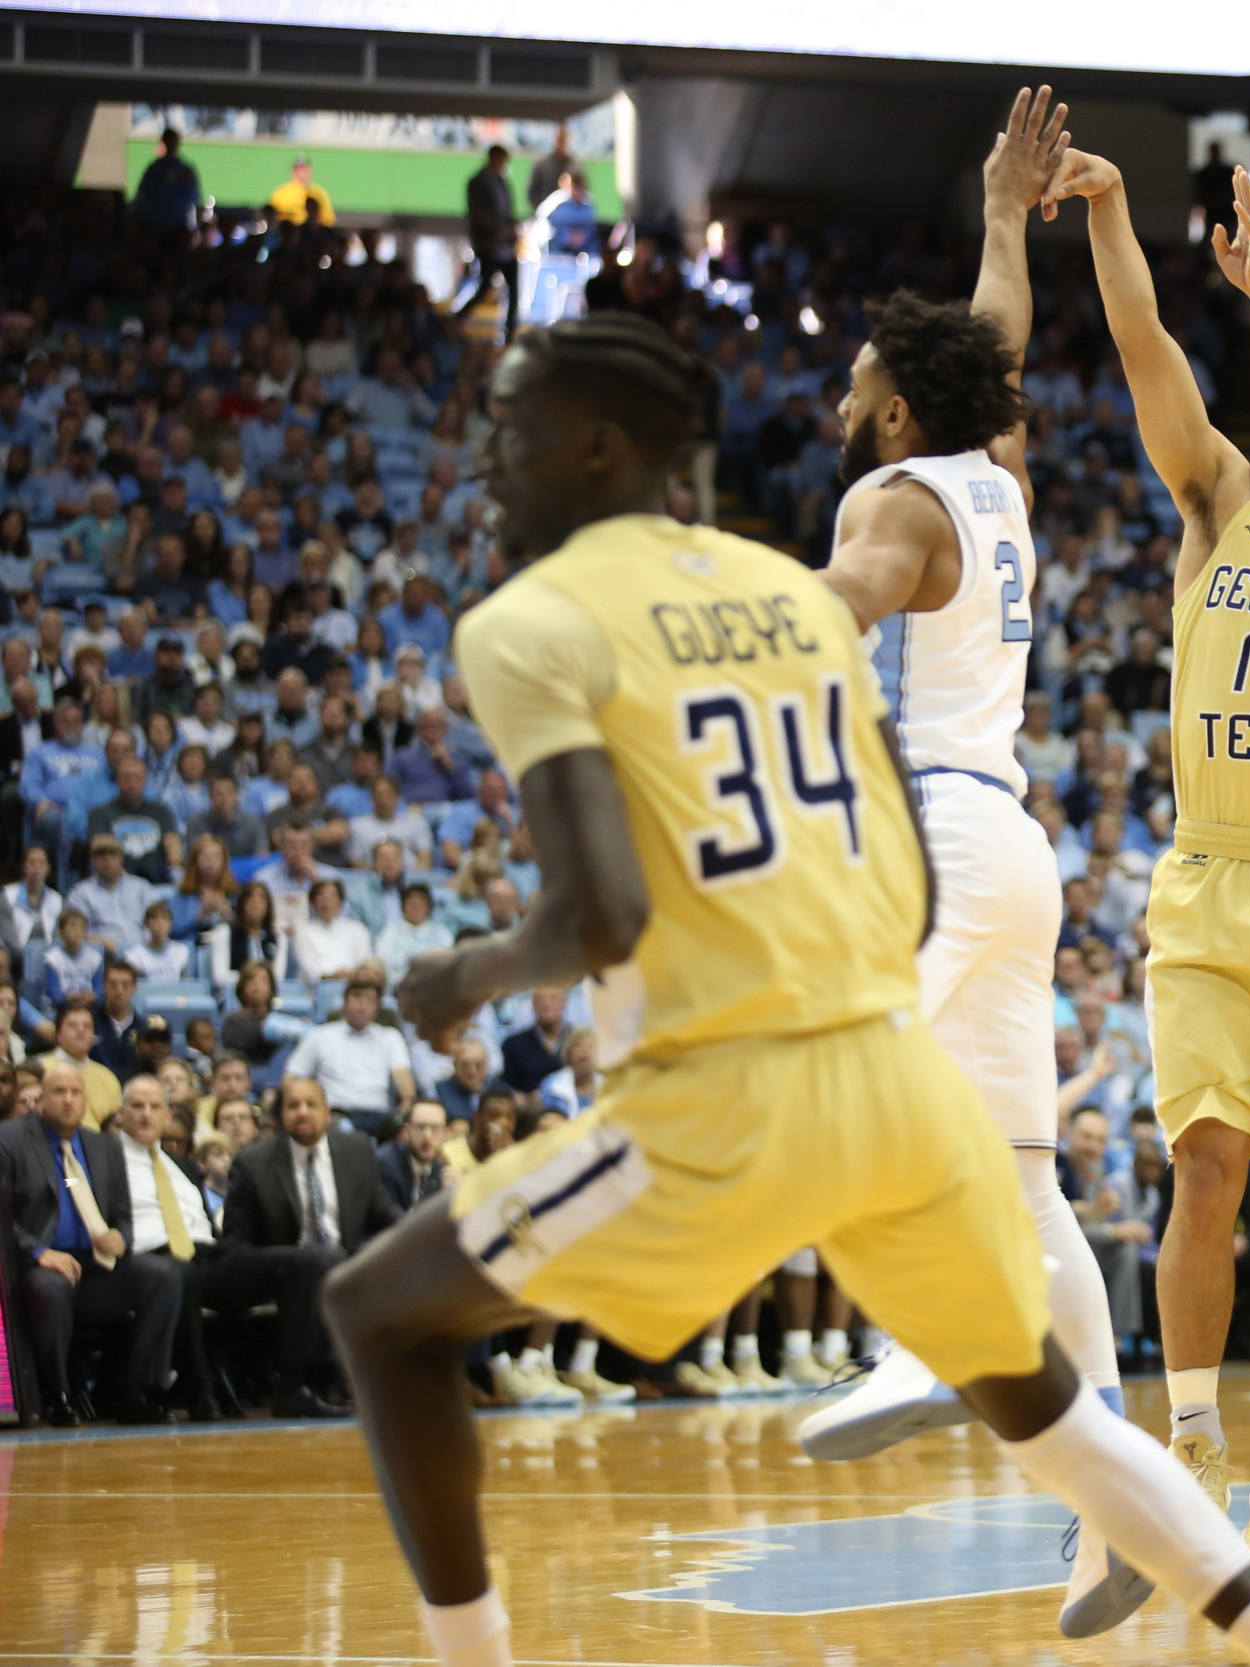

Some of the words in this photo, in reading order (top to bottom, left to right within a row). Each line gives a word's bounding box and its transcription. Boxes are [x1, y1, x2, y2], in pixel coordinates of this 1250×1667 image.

[651, 593, 820, 666] GUEYE
[994, 540, 1033, 642] 2
[677, 672, 863, 890] 34
